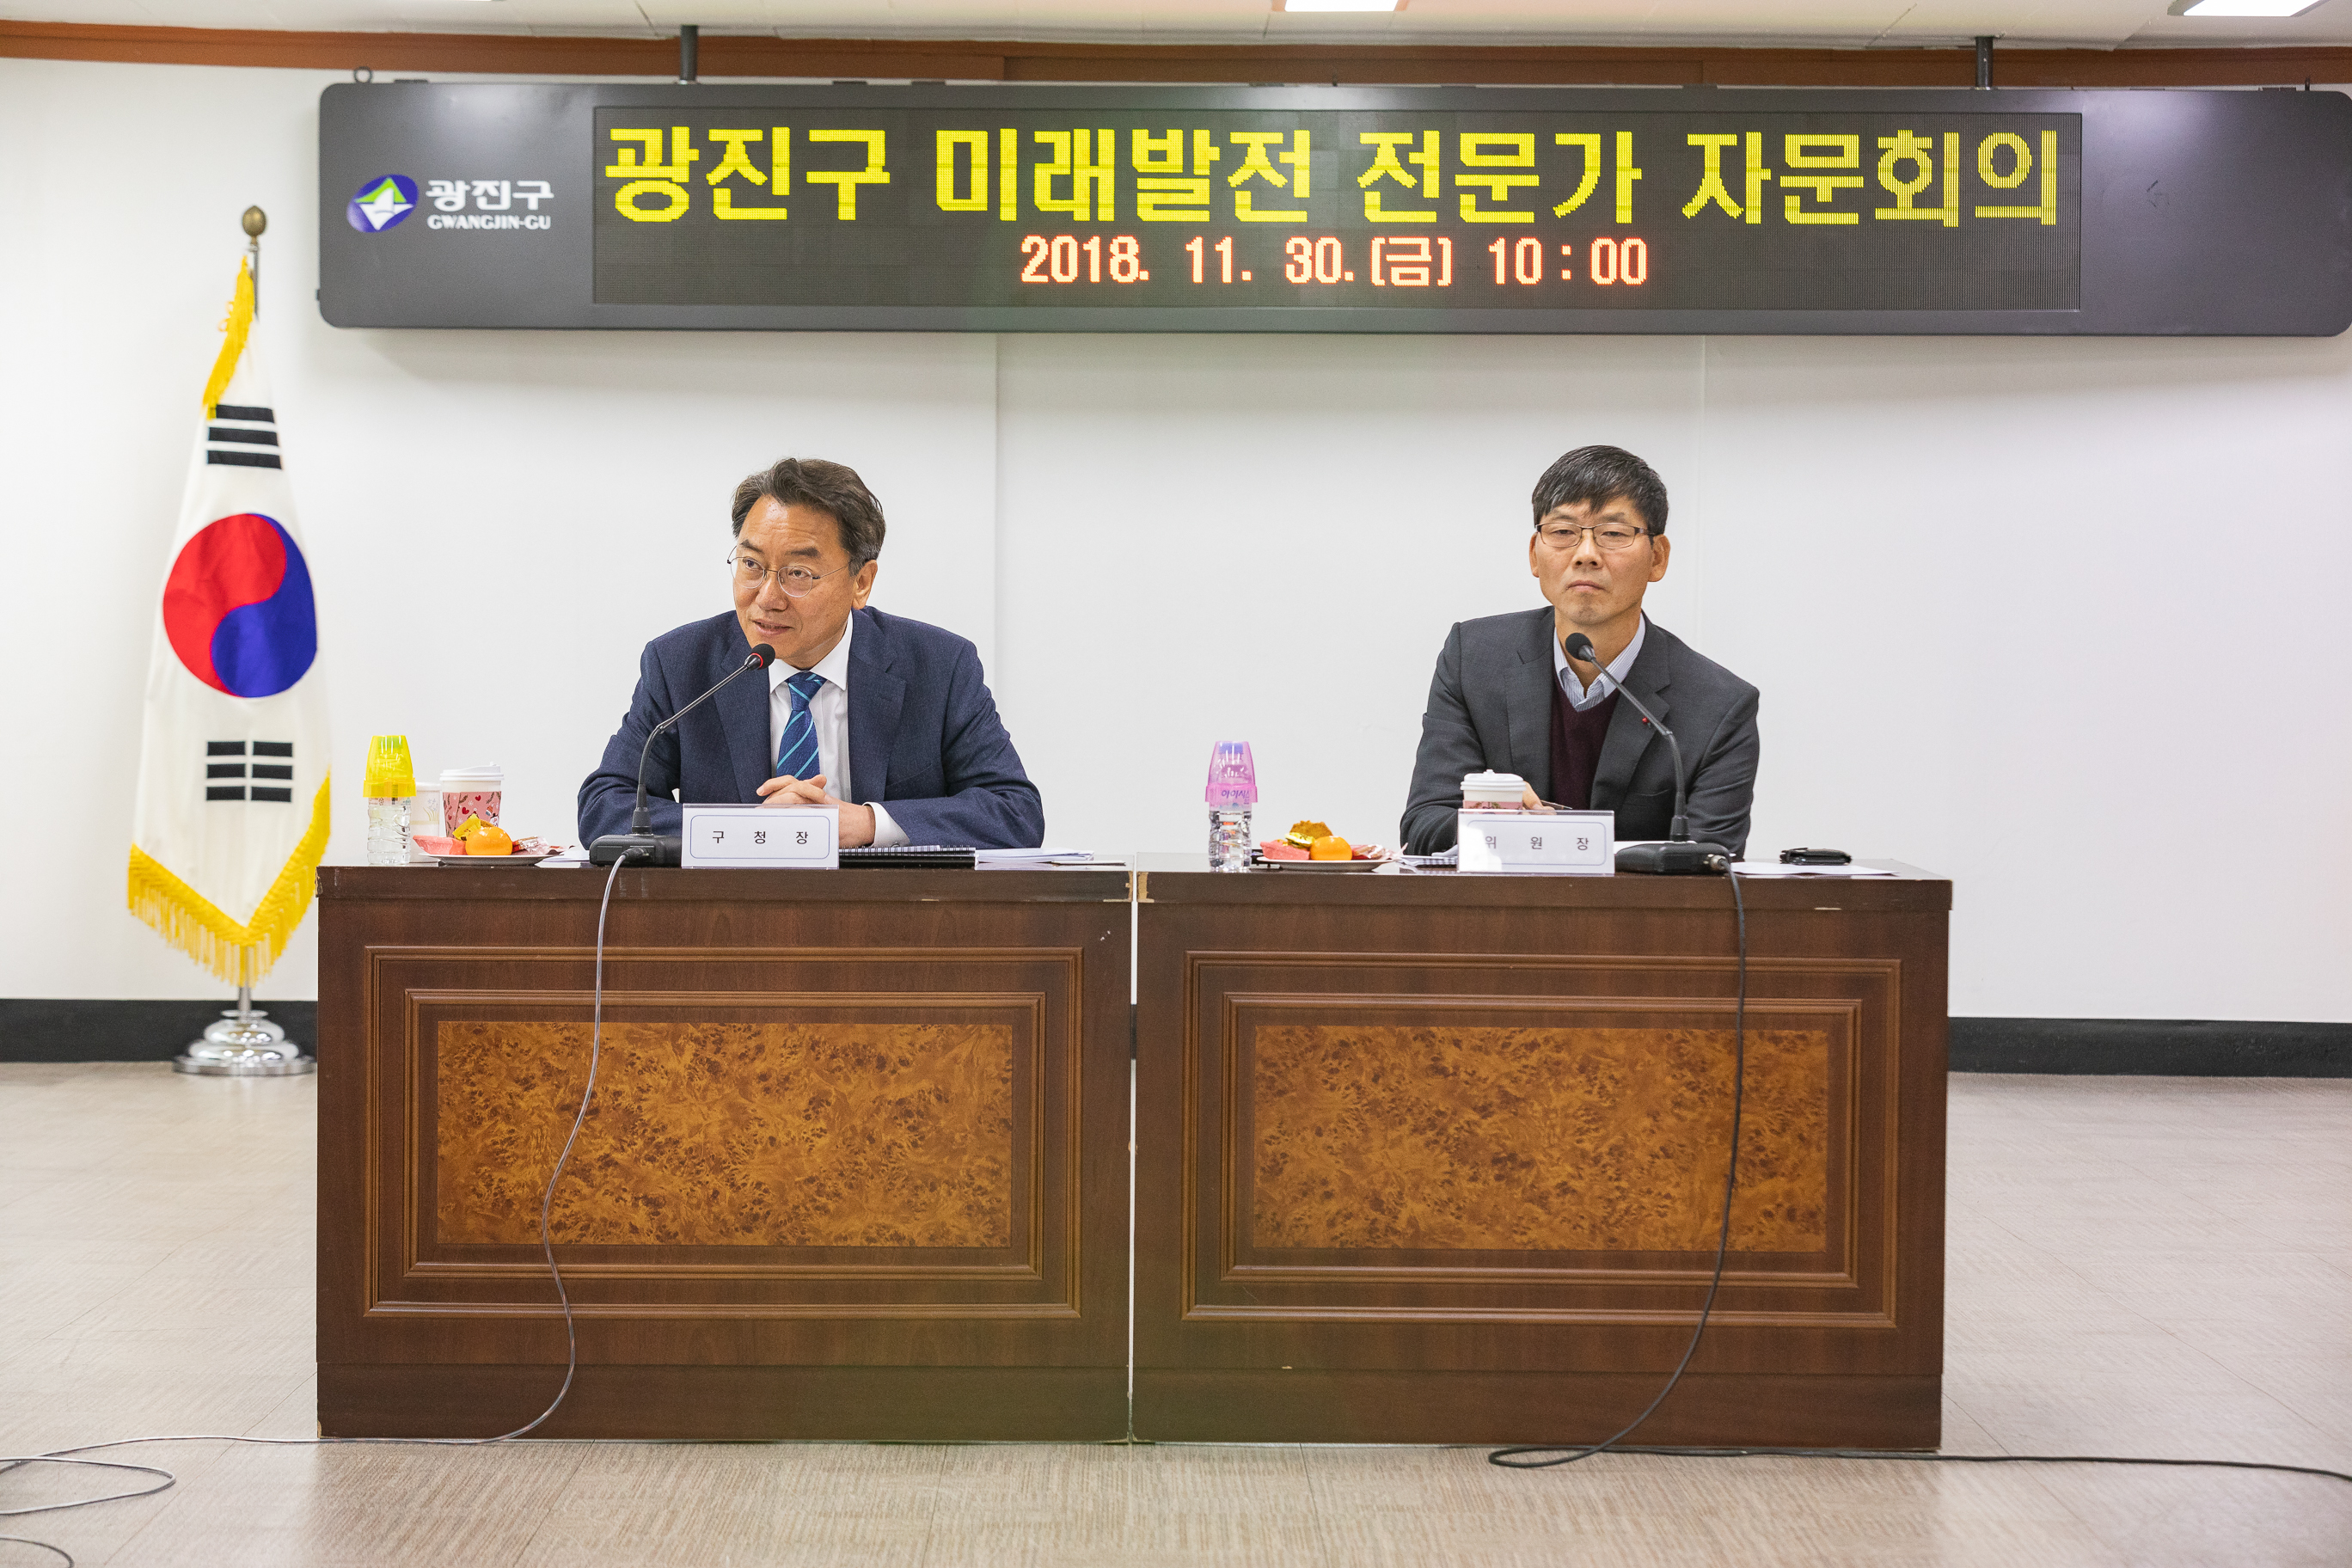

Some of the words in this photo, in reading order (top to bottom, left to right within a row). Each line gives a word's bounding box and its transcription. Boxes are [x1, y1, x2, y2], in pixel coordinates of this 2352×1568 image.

[426, 180, 554, 211] 광진구
[604, 126, 891, 223] 광진구
[935, 128, 1311, 224] 미래발전
[1357, 130, 1643, 224] 전문가
[1681, 129, 2057, 228] 자문회의
[426, 214, 551, 230] GWANGJIN-GU
[1020, 234, 1150, 284] 2018.
[1185, 235, 1253, 284] 11.
